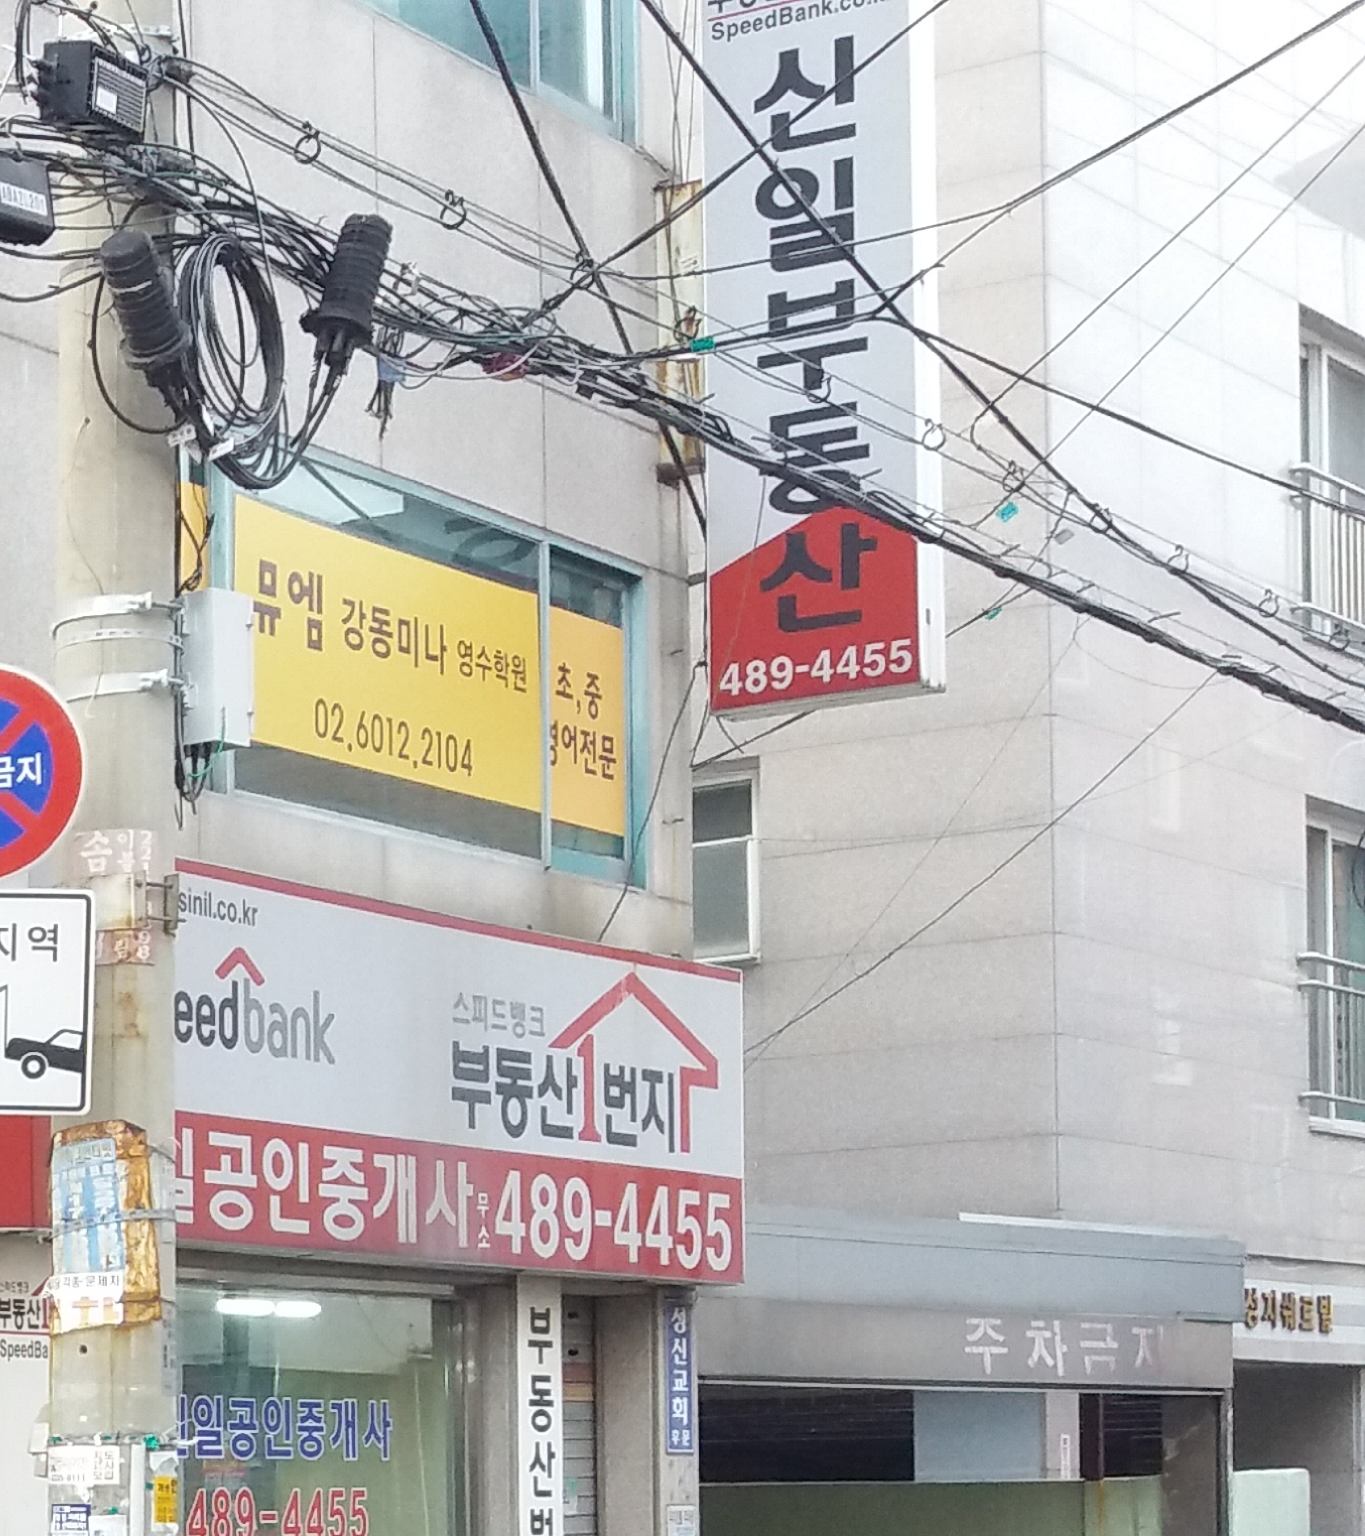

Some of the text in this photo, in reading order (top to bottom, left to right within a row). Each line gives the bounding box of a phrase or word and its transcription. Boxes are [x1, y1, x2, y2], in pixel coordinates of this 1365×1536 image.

[754, 36, 877, 634] 신일부동산
[254, 558, 528, 694] 뮤엠 강동미나 영수학원
[720, 640, 914, 697] 489-4455
[314, 698, 474, 778] 02.6012.2104
[176, 886, 258, 929] sinil.co.kr
[174, 980, 336, 1065] eedbank
[452, 991, 546, 1040] 스피드뱅크
[494, 1169, 732, 1272] 489-4455
[0, 1339, 49, 1360] SpeedBa
[671, 1306, 690, 1426] 성신교회
[964, 1317, 1165, 1378] 주차금지
[528, 1307, 556, 1498] 부동산
